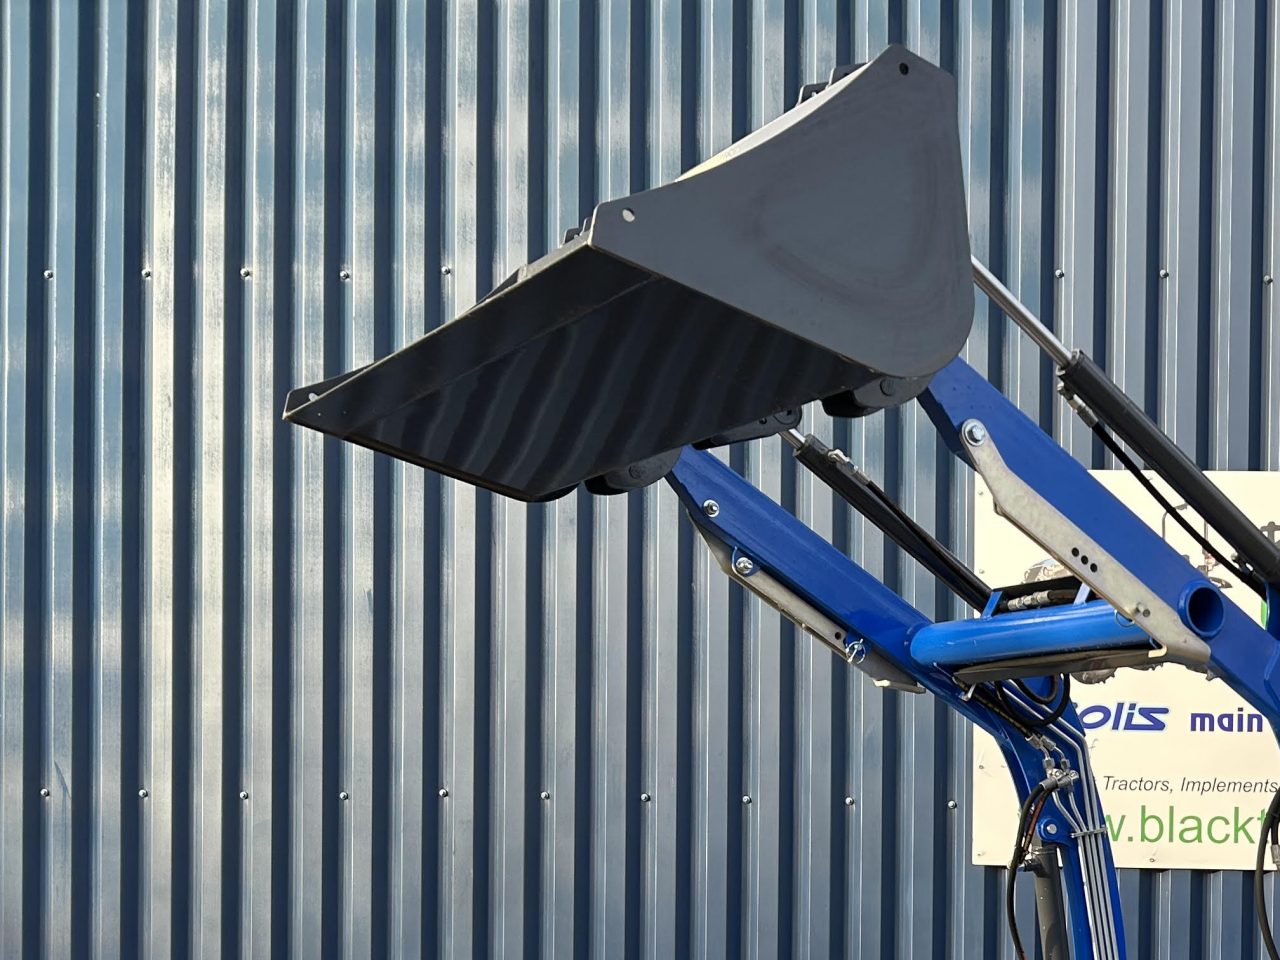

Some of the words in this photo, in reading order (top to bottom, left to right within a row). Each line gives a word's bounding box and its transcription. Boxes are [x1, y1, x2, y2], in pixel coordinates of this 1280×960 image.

[1190, 707, 1264, 732] main
[1103, 775, 1174, 794] Tractors,
[1180, 777, 1279, 796] Implements
